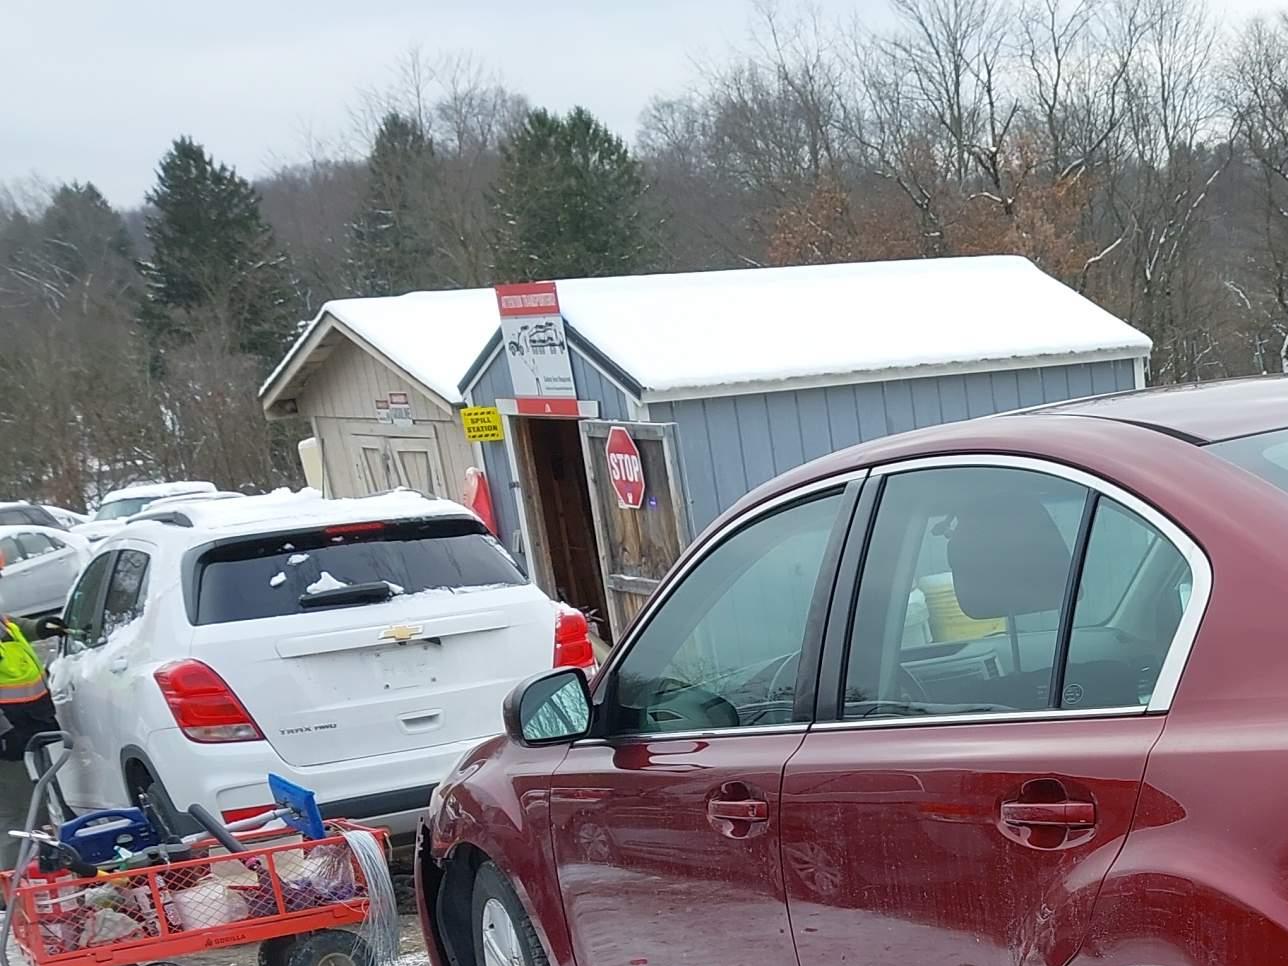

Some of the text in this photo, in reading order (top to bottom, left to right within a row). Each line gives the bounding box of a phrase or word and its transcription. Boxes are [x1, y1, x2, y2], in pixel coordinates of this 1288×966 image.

[470, 416, 491, 424] SPILL
[467, 424, 498, 433] STATION
[609, 453, 640, 482] STOP
[279, 726, 312, 736] TRAX
